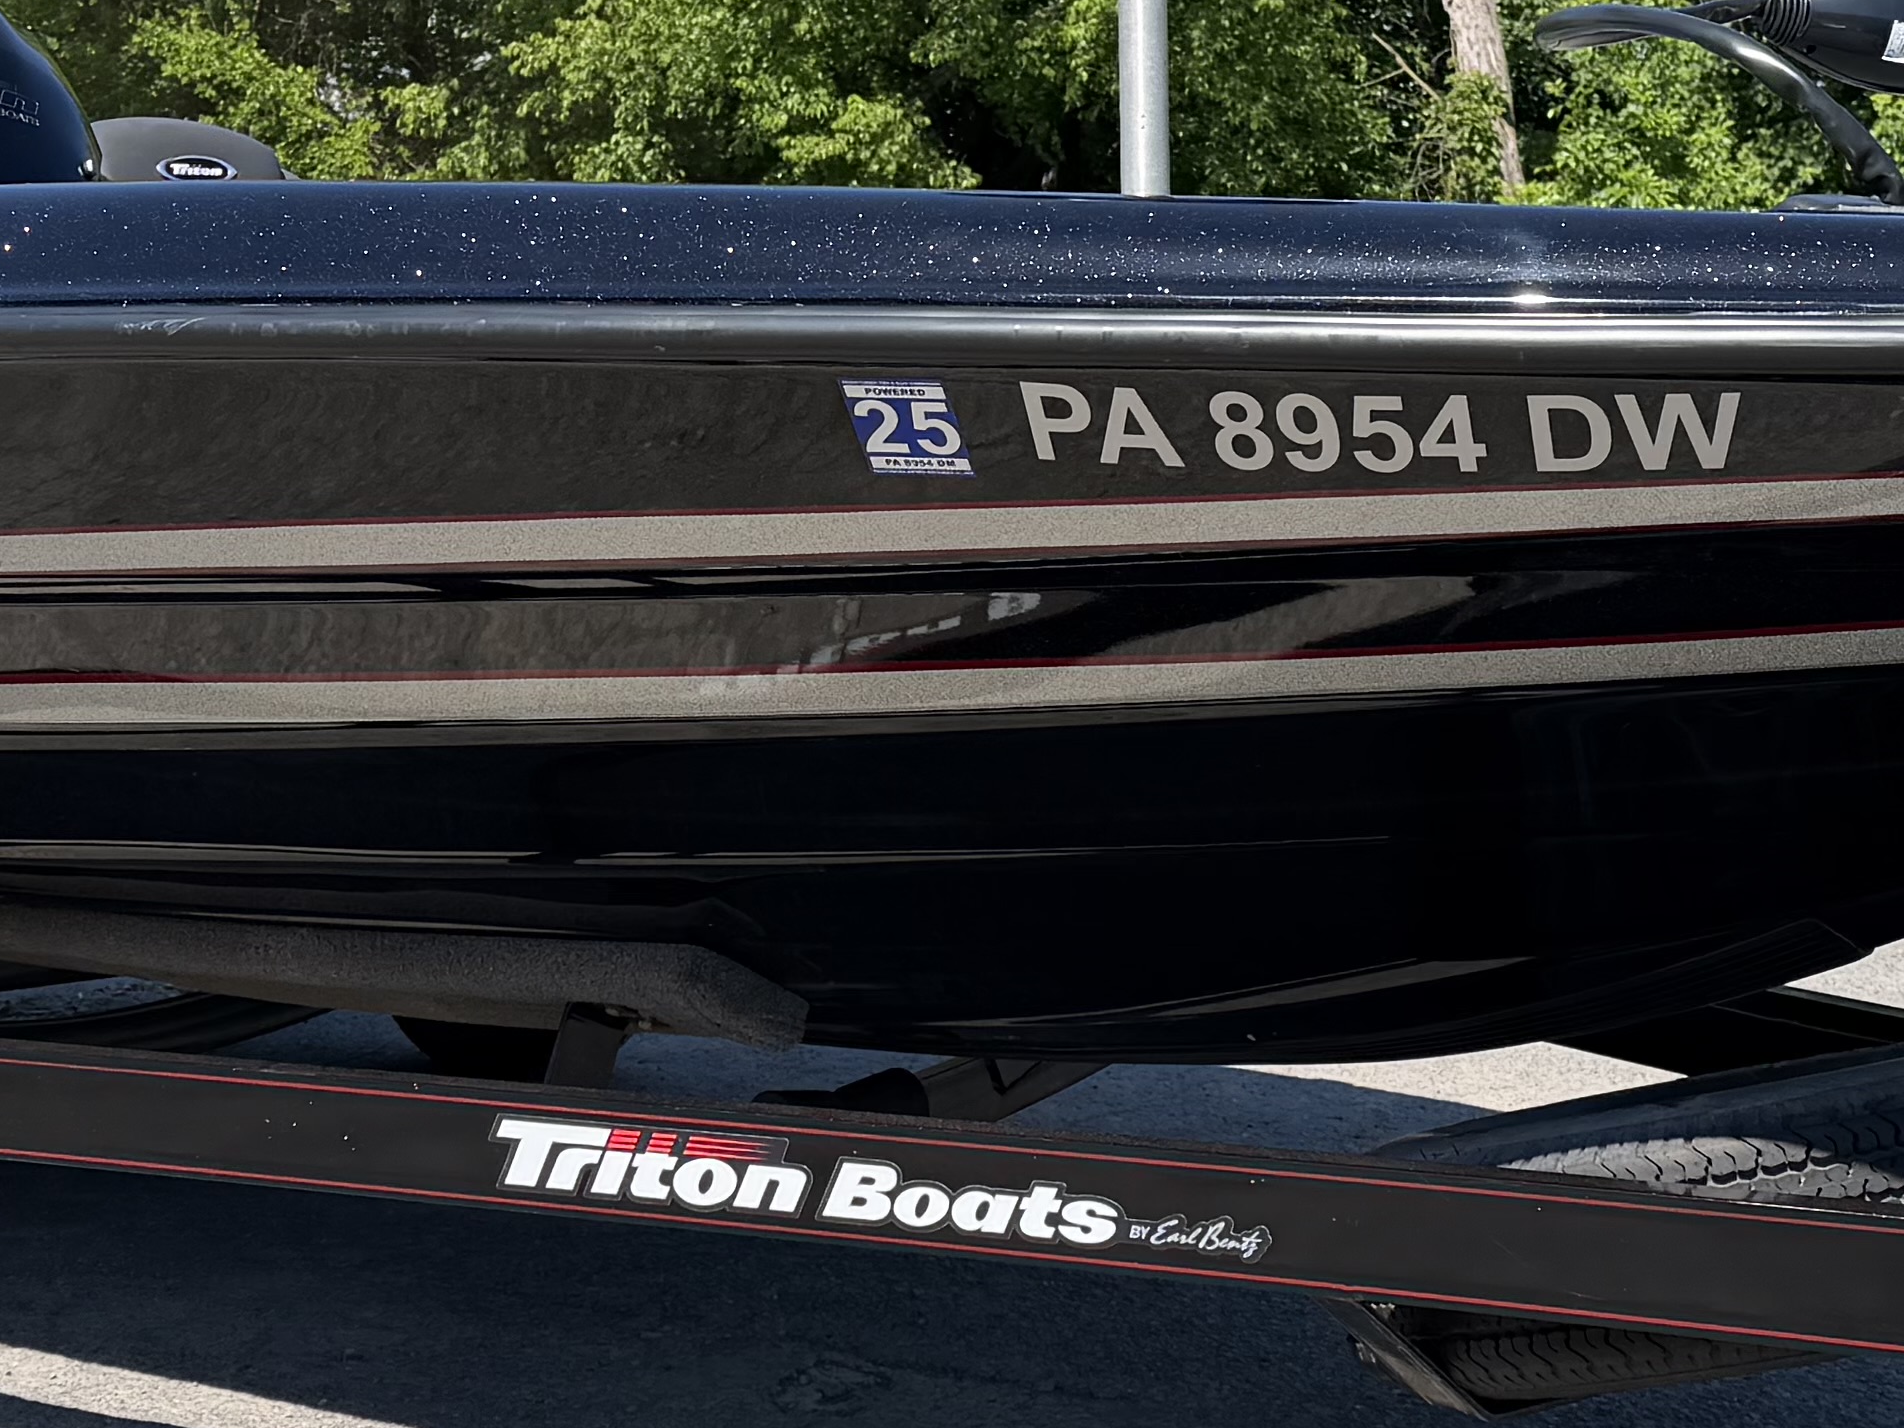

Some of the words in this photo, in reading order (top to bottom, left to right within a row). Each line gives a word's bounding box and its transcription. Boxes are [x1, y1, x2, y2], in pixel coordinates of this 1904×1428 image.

[169, 163, 223, 176] Triton
[853, 399, 961, 456] 25
[1019, 380, 1186, 468] PA
[1208, 390, 1487, 473] 8954
[1526, 392, 1742, 472] DW
[496, 1118, 808, 1213] Triton
[822, 1161, 1119, 1245] Boats
[1129, 1224, 1150, 1239] BY
[1150, 1219, 1202, 1245] Earl
[1198, 1221, 1262, 1259] Bentz
